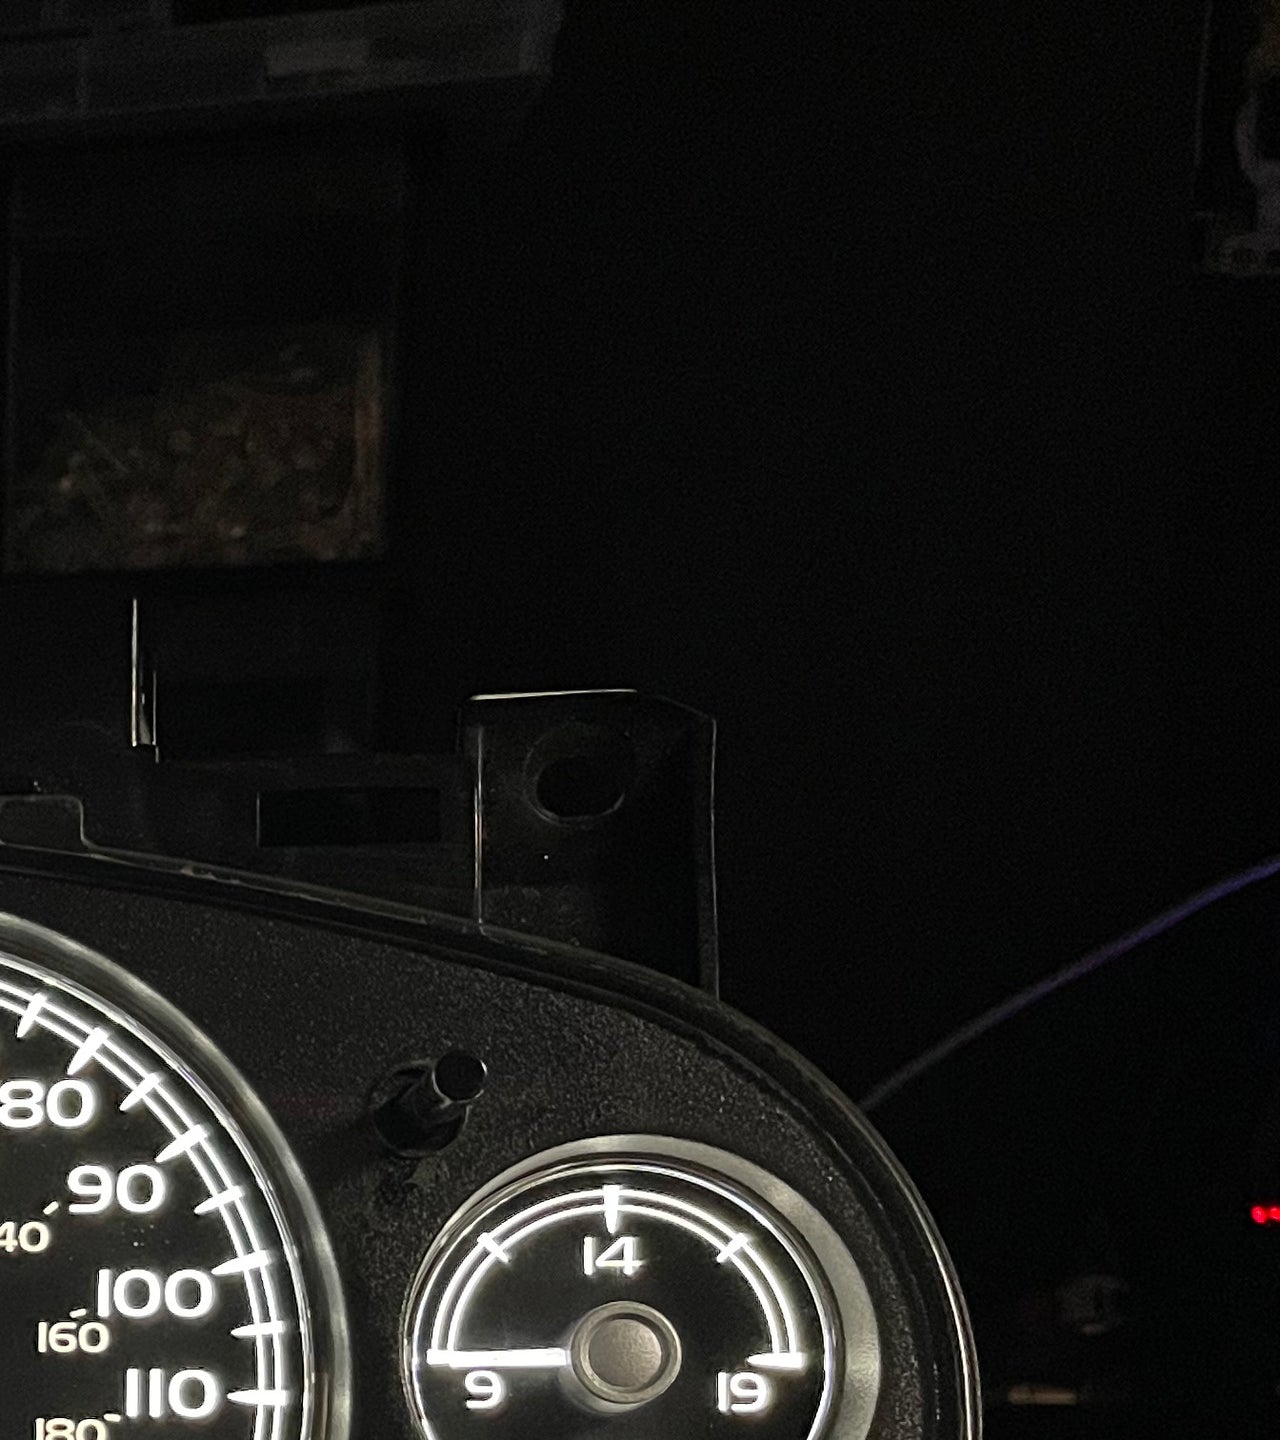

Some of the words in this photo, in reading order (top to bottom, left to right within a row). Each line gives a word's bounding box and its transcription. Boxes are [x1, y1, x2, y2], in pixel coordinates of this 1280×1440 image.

[68, 1165, 165, 1212] 90
[584, 1237, 641, 1275] 14
[98, 1270, 212, 1317] 100
[39, 1322, 108, 1352] 160
[127, 1369, 217, 1417] 110
[465, 1371, 501, 1408] 9
[718, 1372, 767, 1411] 19
